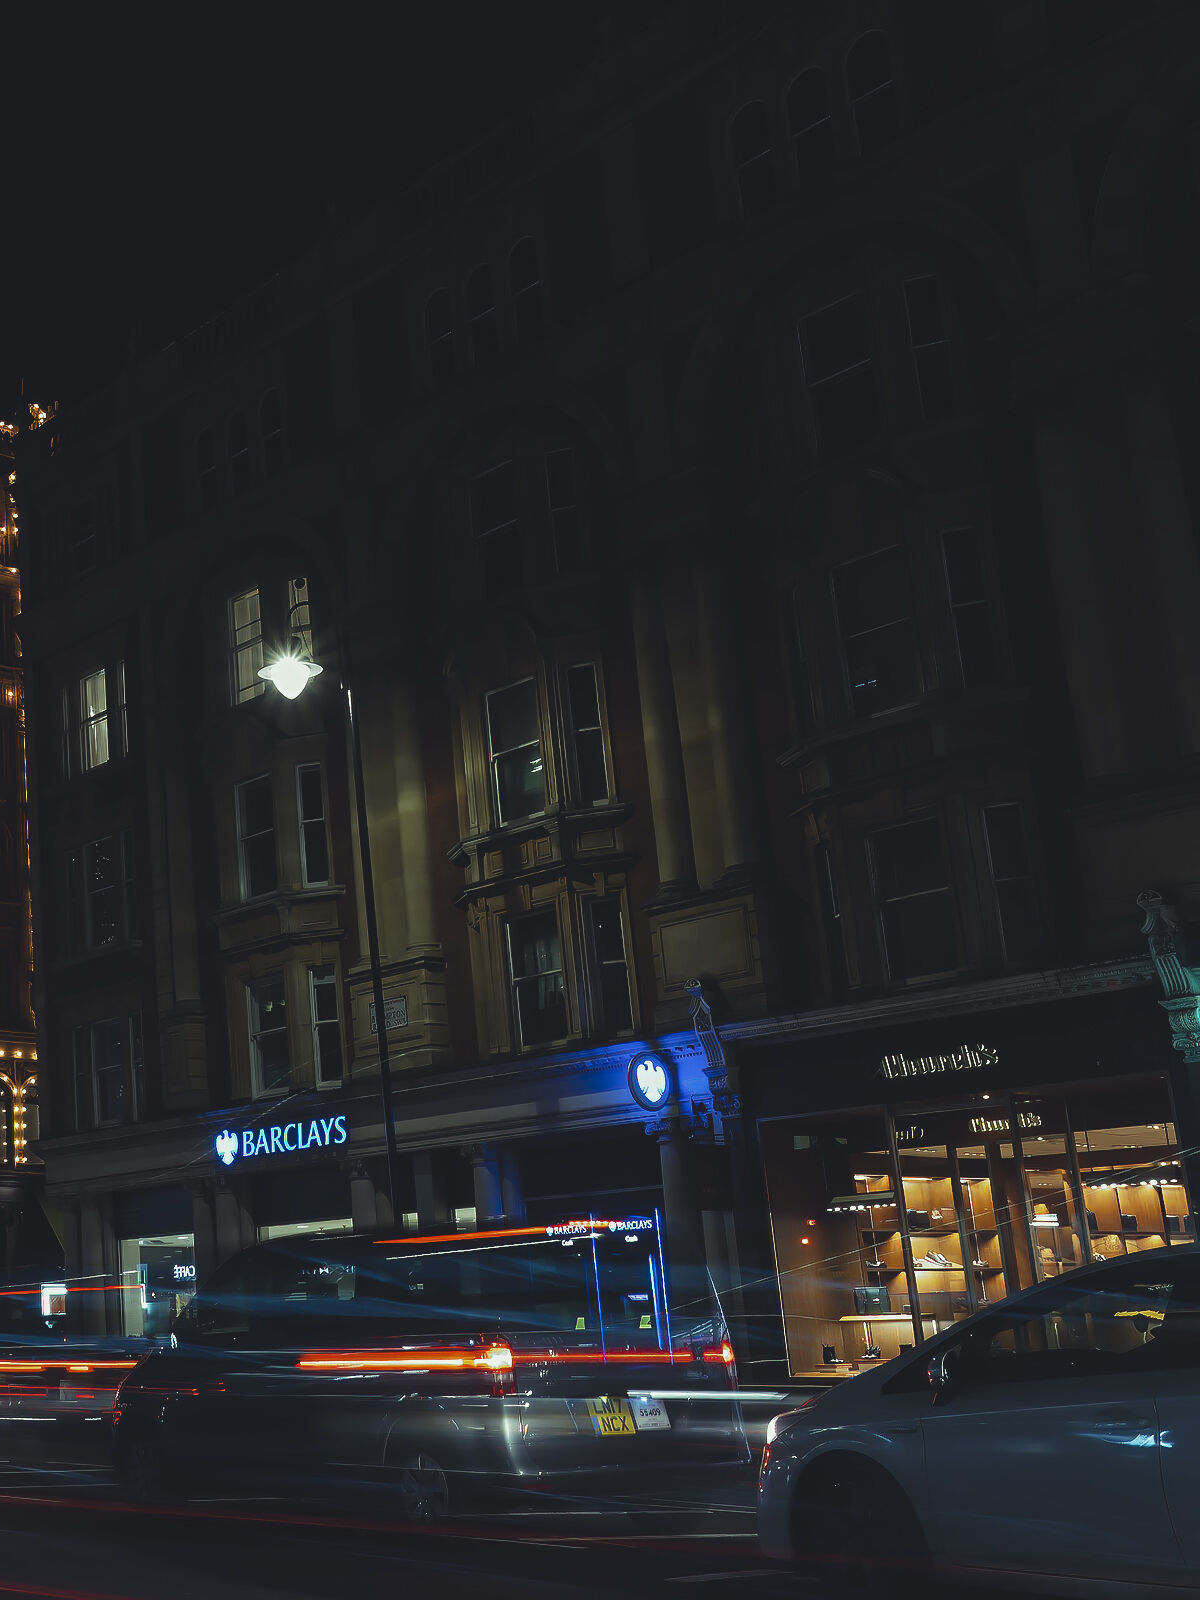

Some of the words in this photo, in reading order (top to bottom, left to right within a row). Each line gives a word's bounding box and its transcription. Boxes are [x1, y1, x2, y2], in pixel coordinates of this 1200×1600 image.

[880, 1043, 999, 1079] Church's
[242, 1115, 347, 1156] BARCLAYS
[554, 1225, 587, 1235] BARCLAYS
[616, 1219, 653, 1231] BARCLAYS
[601, 1416, 629, 1432] NCX
